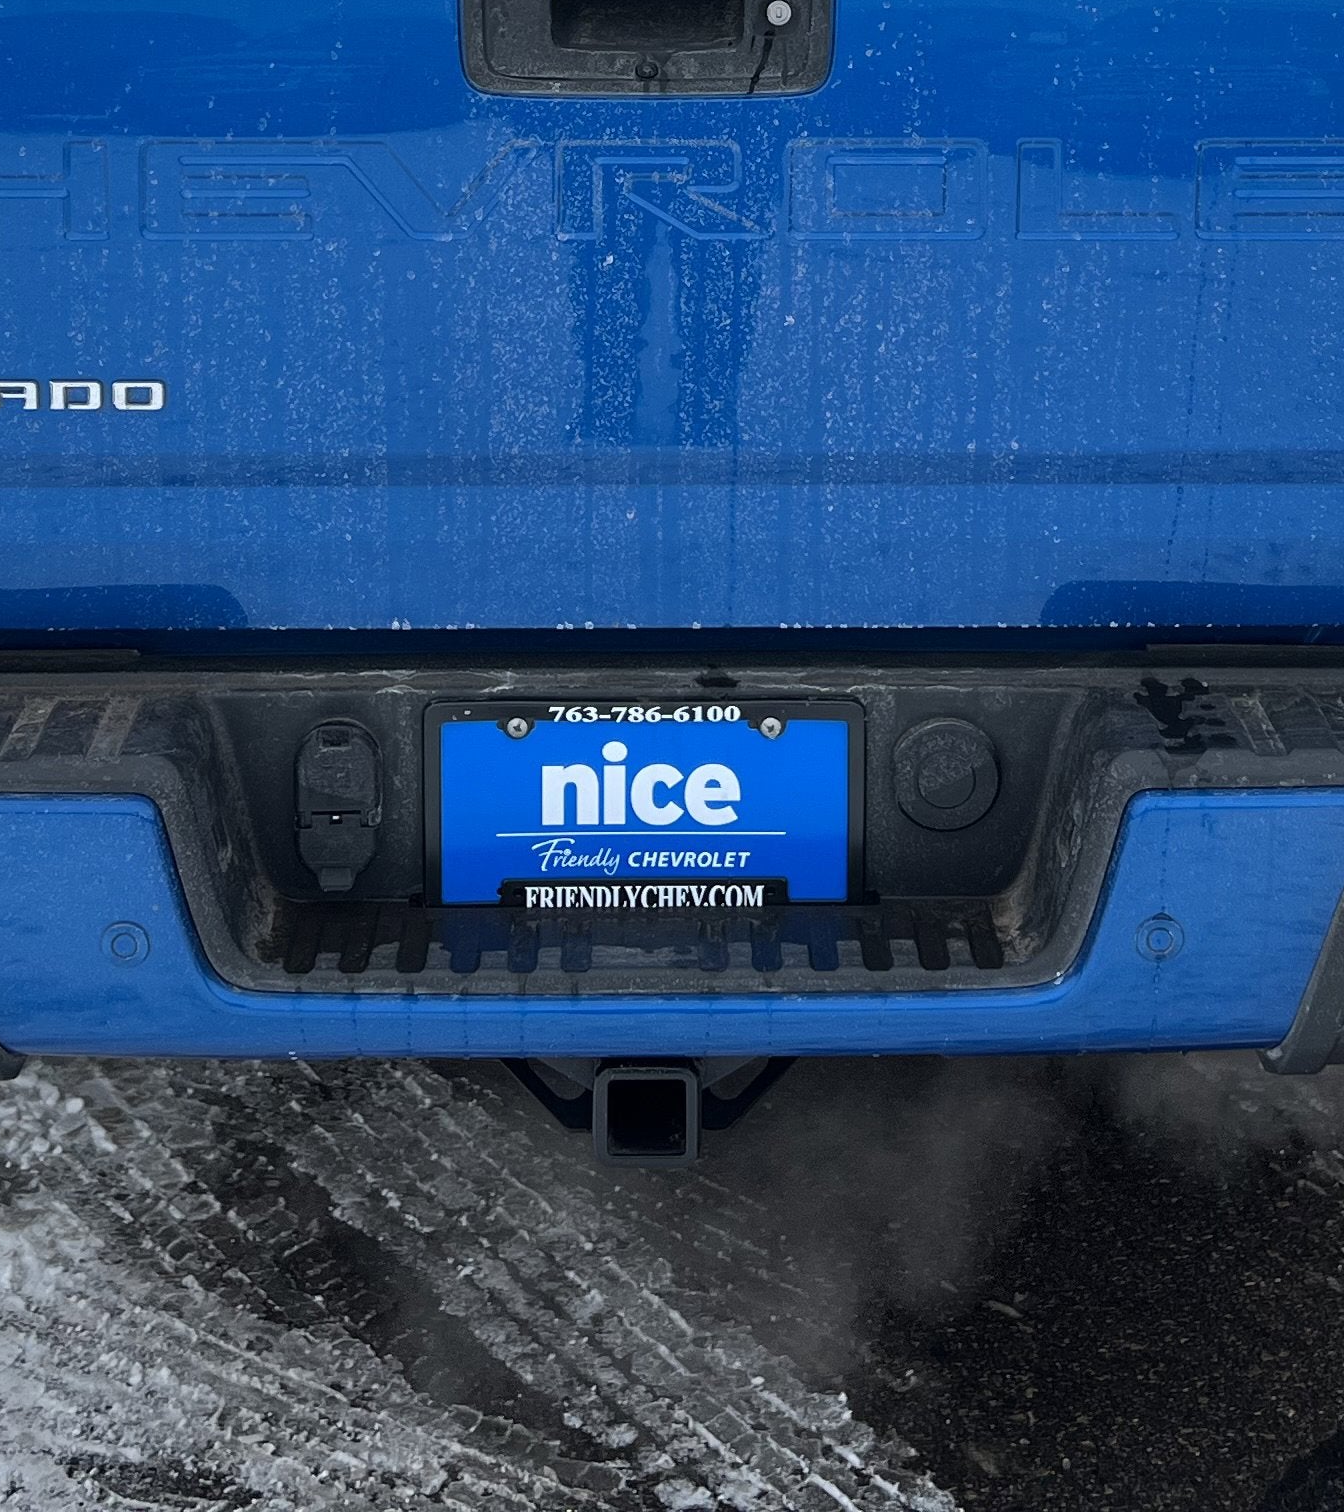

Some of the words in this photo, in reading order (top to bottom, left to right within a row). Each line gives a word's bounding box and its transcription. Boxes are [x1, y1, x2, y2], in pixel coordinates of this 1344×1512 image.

[548, 705, 741, 723] 763-786-6100
[542, 741, 741, 826] nice
[530, 837, 621, 876] Friendly
[627, 851, 751, 869] CHEVROLET
[524, 884, 765, 909] FRIENDLYCHEV.COM
